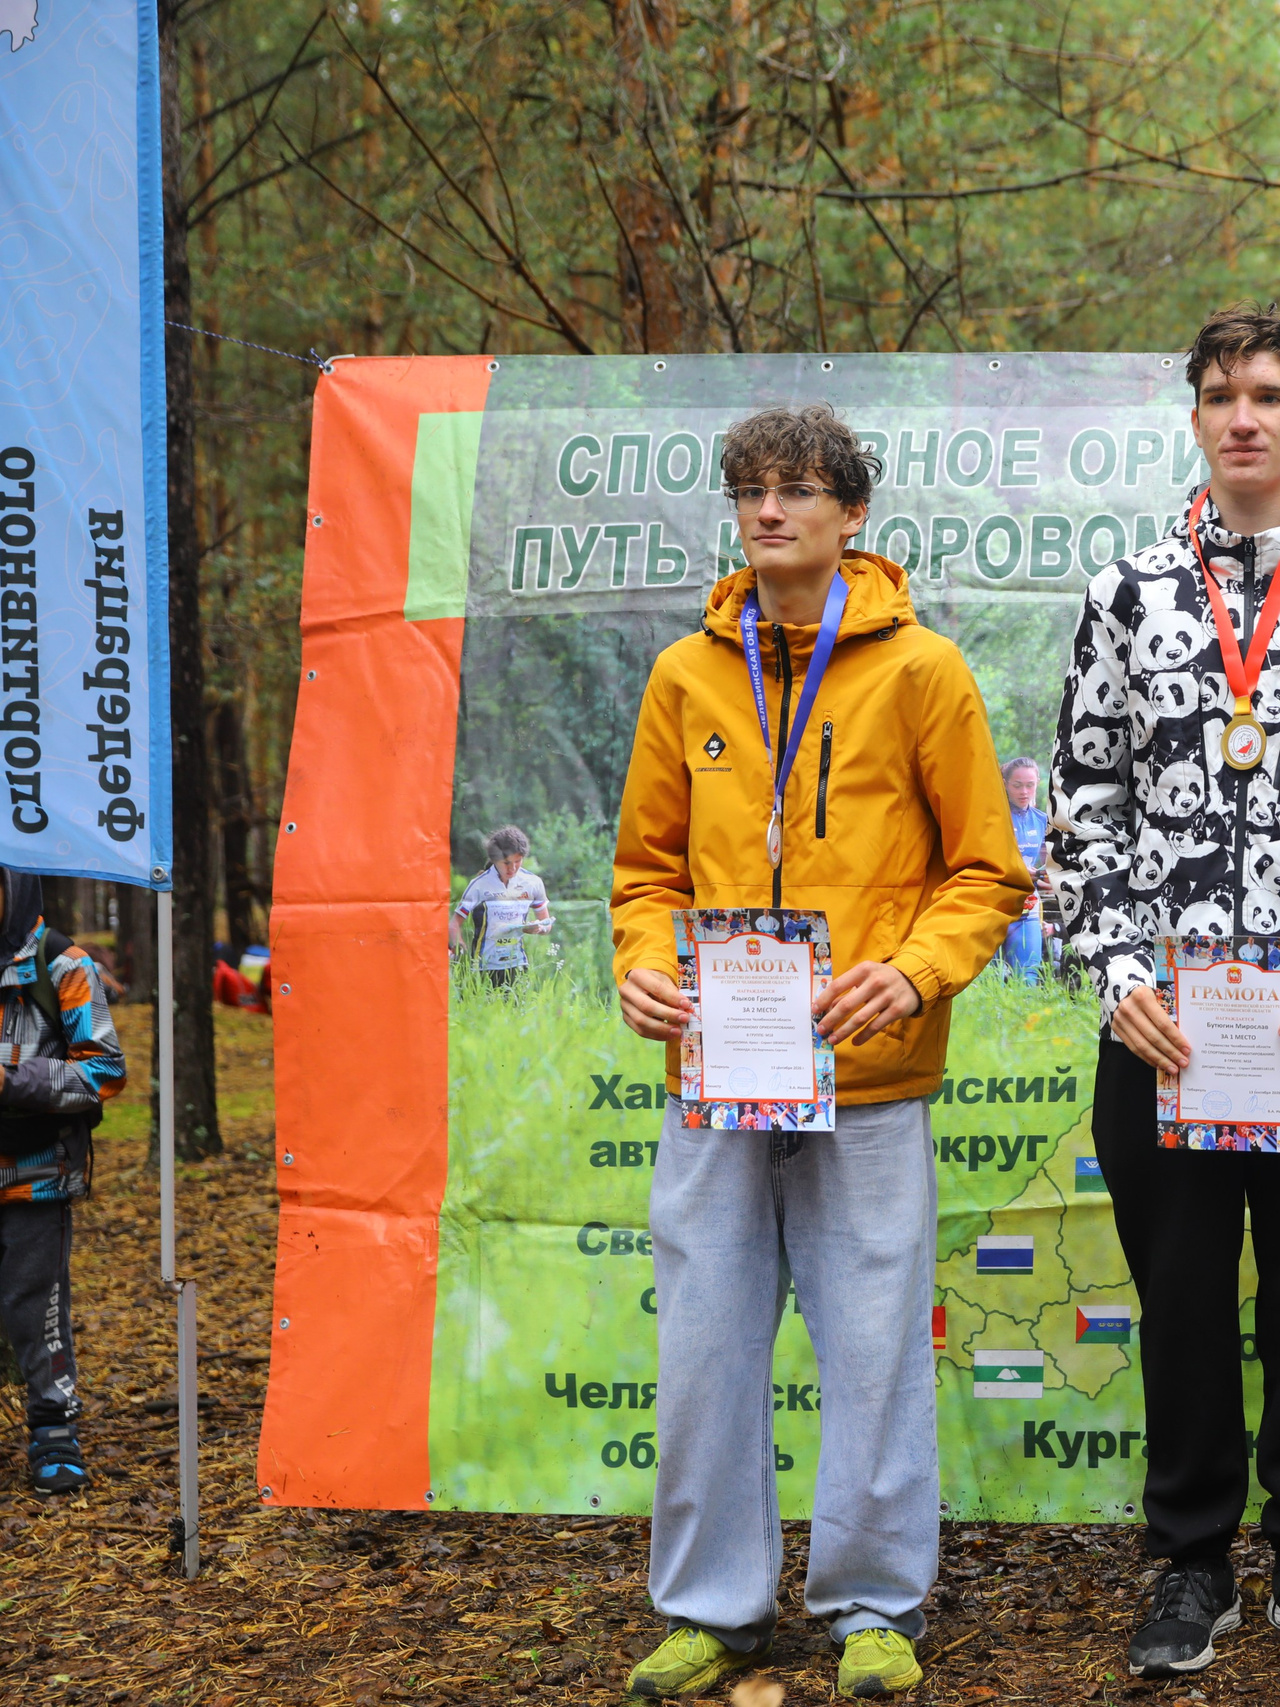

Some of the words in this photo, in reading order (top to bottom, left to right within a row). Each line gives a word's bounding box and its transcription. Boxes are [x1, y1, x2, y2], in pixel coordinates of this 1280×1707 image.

[557, 427, 1042, 498] СПОВНОЕ
[510, 521, 688, 591] ПУТЬ
[746, 607, 758, 648] ОБЛАСТЬ
[749, 649, 767, 729] ЧЕЛЯБИНСКАЯ
[712, 958, 799, 973] ГРАМОТА
[1190, 986, 1280, 1002] ГРАМОТА
[932, 1135, 1048, 1172] круг
